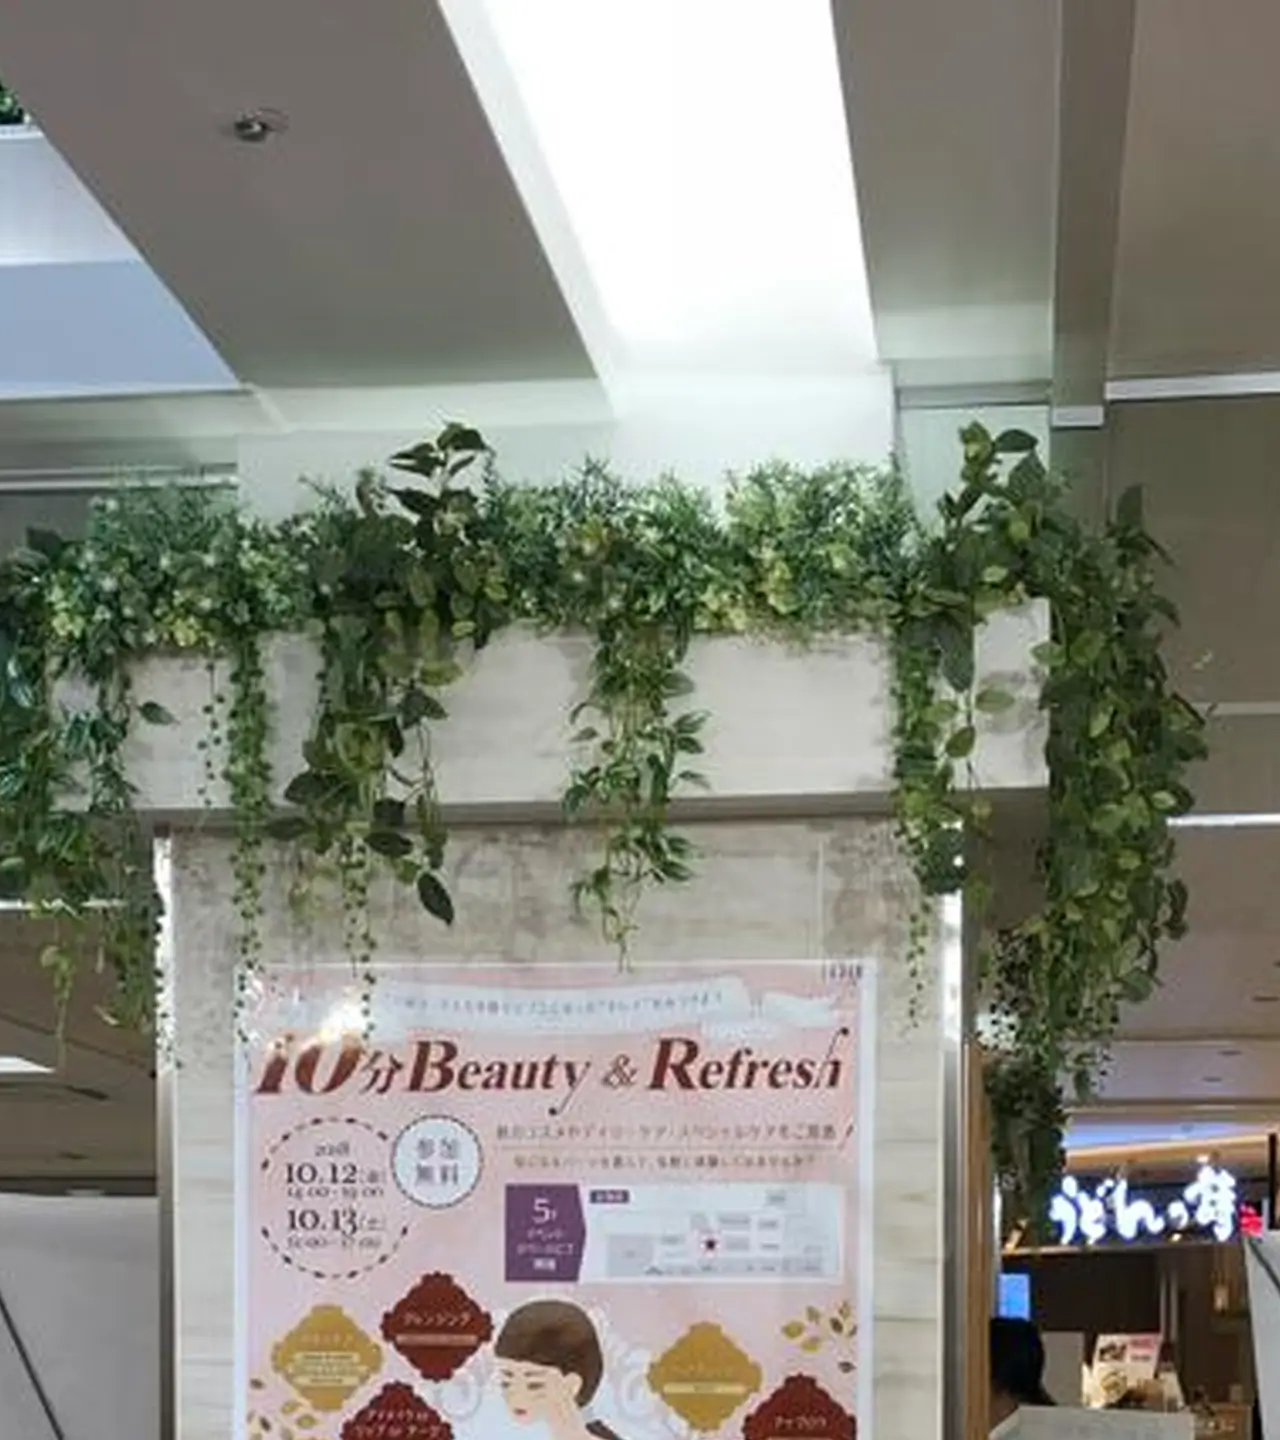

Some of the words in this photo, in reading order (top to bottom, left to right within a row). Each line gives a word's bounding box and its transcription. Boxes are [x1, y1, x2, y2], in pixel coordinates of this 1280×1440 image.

[404, 1039, 591, 1117] Beauty
[601, 1051, 639, 1088] &
[286, 1162, 357, 1185] 10.12
[288, 1207, 358, 1235] 10.13
